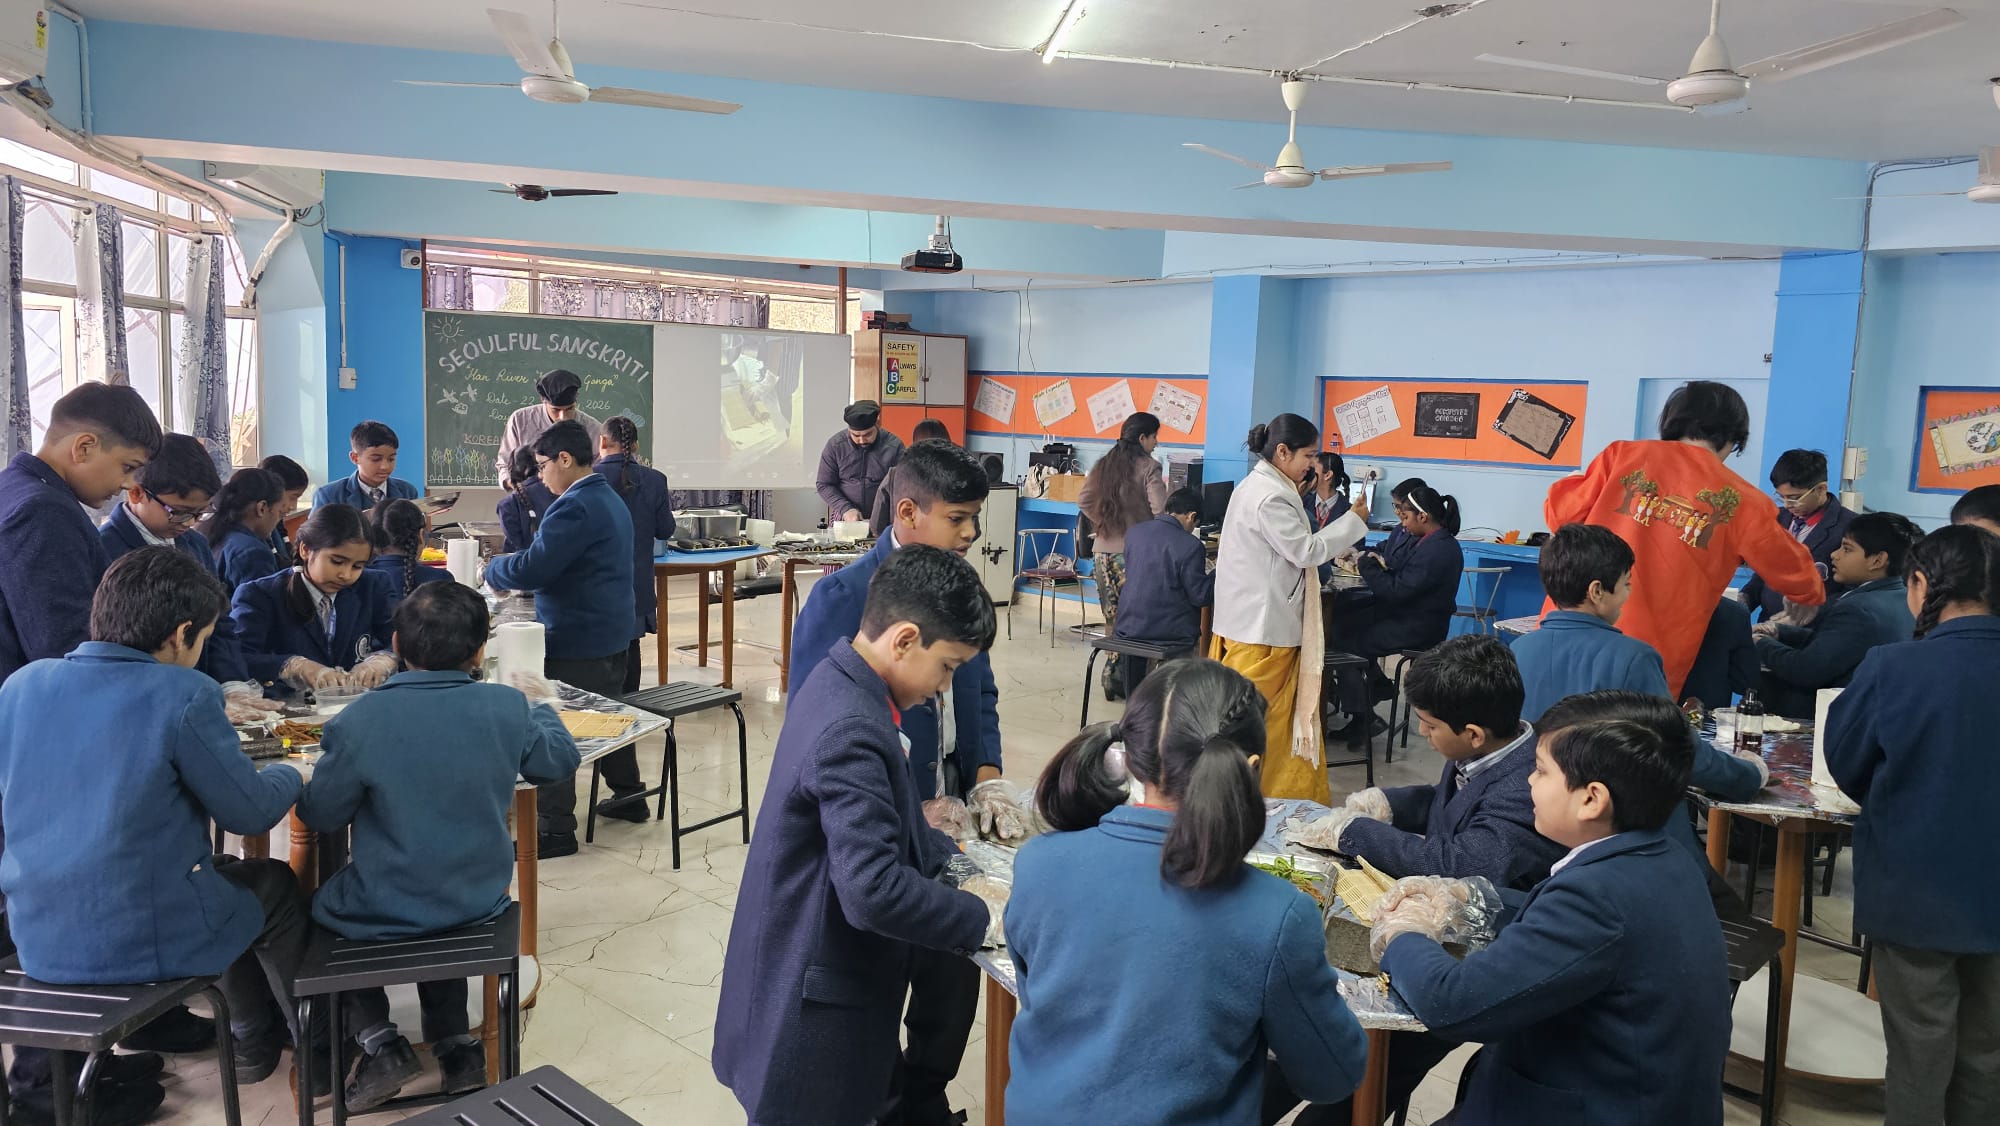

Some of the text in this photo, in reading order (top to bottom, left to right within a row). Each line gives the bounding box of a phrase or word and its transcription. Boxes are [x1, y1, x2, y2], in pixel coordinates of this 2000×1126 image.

[887, 342, 915, 351] SAFETY
[439, 333, 650, 383] SEOULFUL SANSKRITI
[891, 359, 917, 370] ALWAYS
[496, 368, 529, 383] River
[891, 371, 904, 382] BE
[887, 383, 917, 393] CAREFUL
[486, 391, 511, 405] Date
[520, 395, 535, 405] 22
[585, 400, 611, 410] 2026
